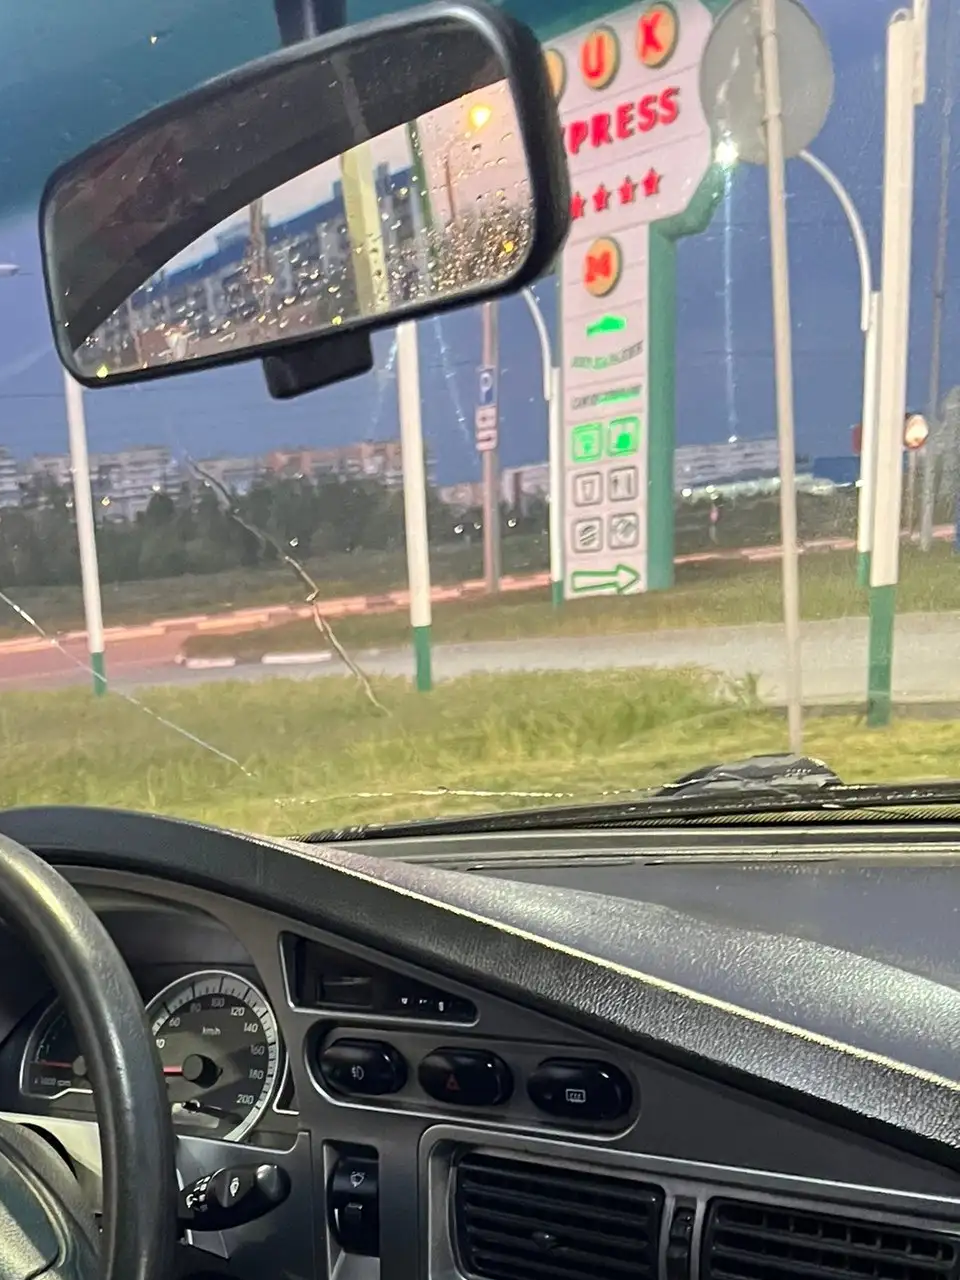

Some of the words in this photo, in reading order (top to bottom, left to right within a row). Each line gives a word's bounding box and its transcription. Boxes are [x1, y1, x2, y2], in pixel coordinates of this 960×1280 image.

[580, 8, 666, 80] UK
[561, 85, 681, 156] PRESS
[230, 1006, 246, 1017] 120
[169, 1017, 181, 1027] 60
[243, 1022, 259, 1033] 140
[250, 1045, 266, 1056] 160
[248, 1068, 264, 1080] 180
[236, 1093, 255, 1105] 200
